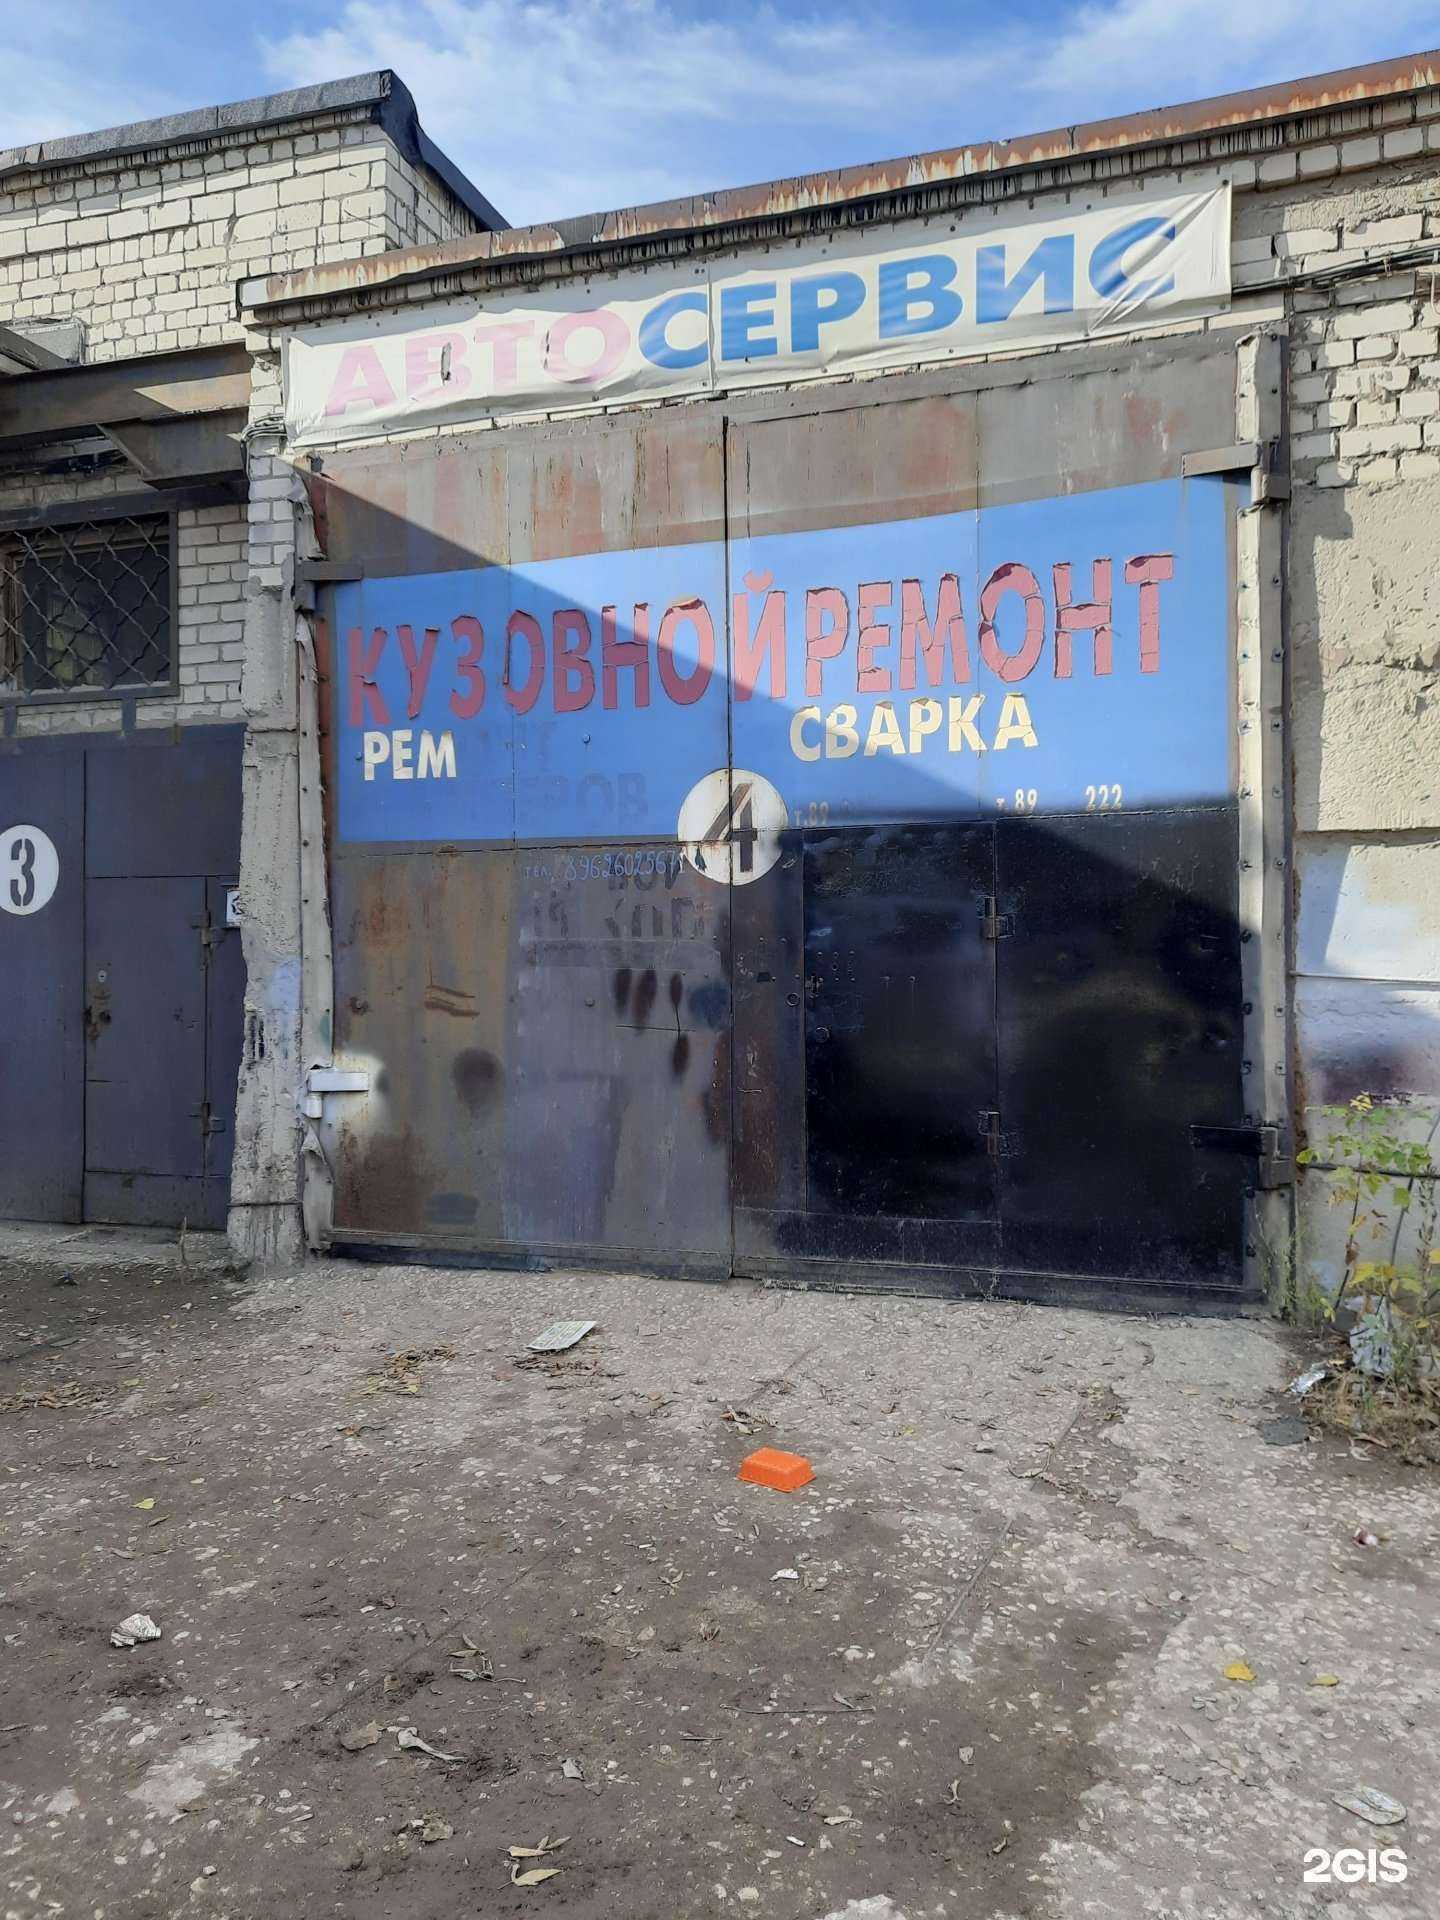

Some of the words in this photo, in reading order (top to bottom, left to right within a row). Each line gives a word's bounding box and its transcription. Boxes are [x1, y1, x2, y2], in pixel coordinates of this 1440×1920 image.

[322, 215, 1180, 416] АВТОСЕРВИС
[347, 568, 786, 728] КУЗОВНОЙ
[804, 553, 1175, 698] РЕМОНТ
[363, 729, 457, 782] РЕМ
[789, 692, 1040, 763] СВАРКА
[702, 781, 758, 874] 4
[1084, 783, 1123, 812] 222
[10, 838, 35, 907] 3
